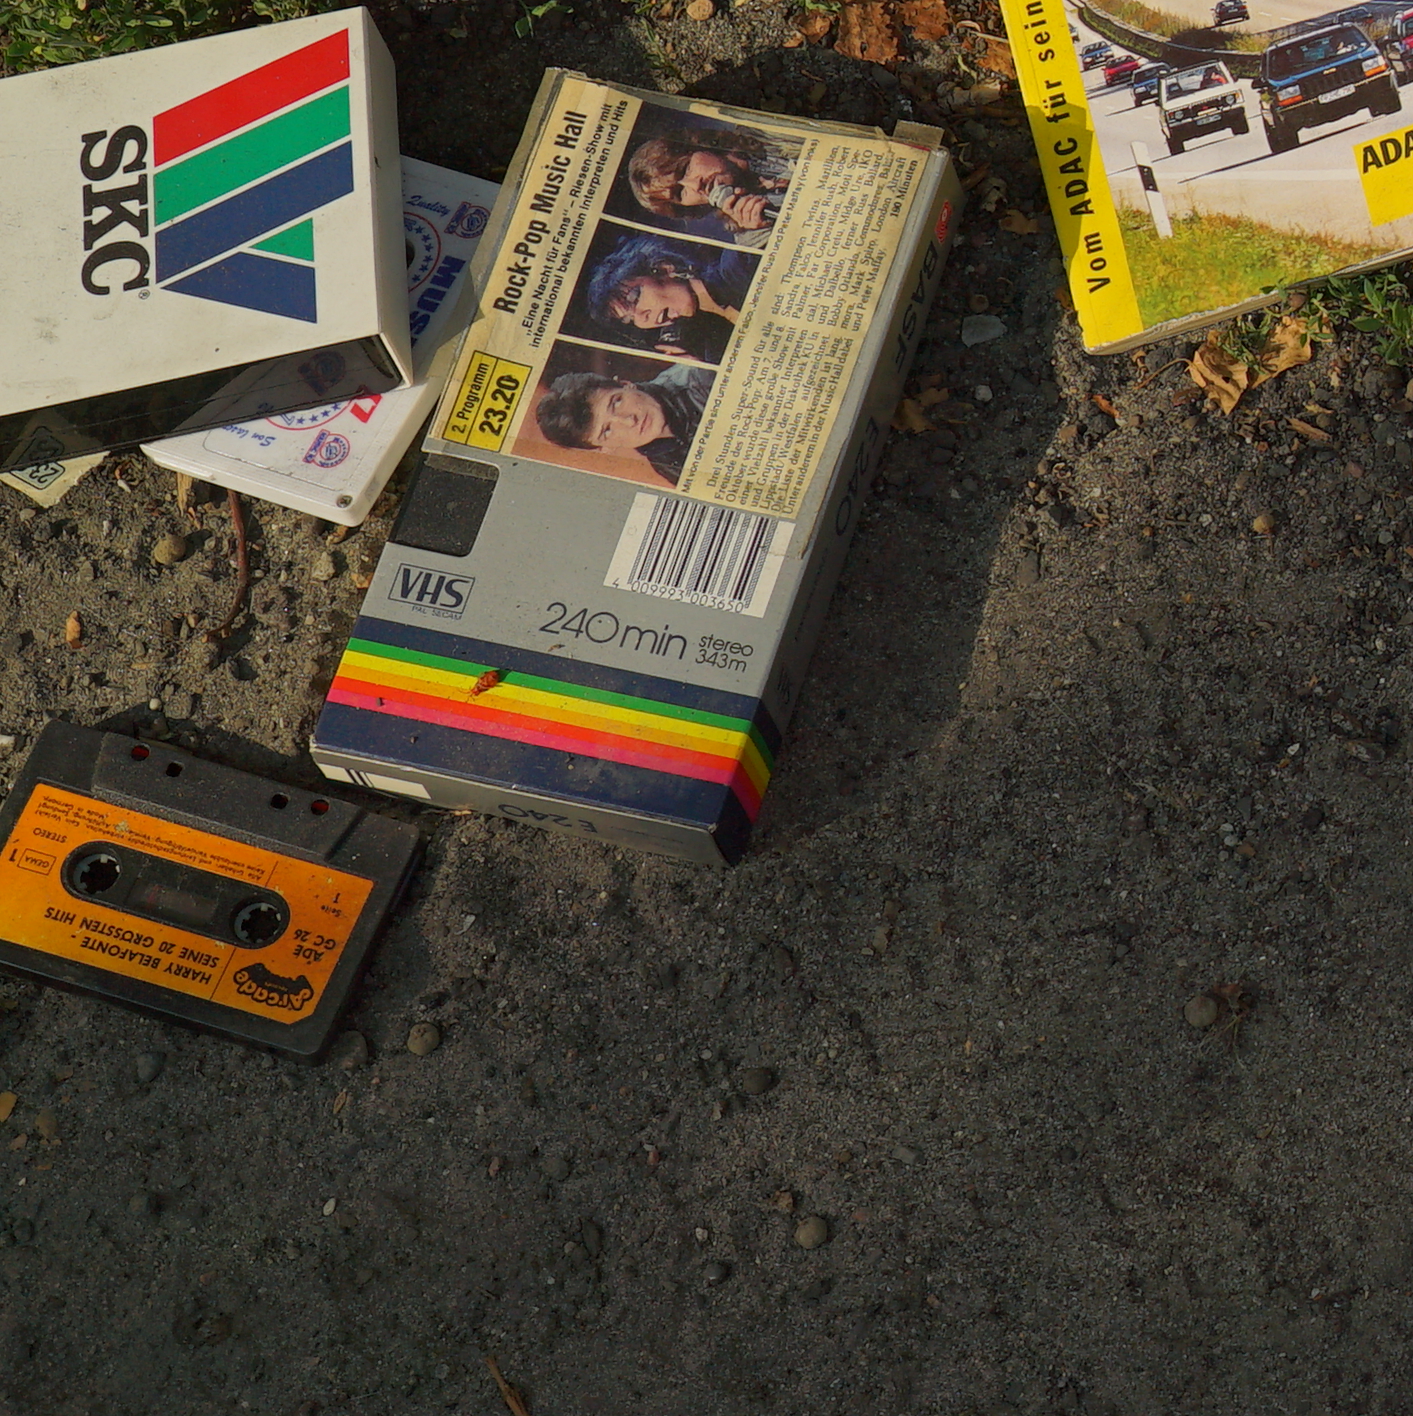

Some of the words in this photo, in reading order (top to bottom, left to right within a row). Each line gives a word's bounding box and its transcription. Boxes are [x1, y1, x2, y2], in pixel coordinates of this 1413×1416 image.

[610, 99, 628, 121] Hits
[1038, 77, 1071, 123] für
[603, 122, 620, 145] und
[577, 146, 614, 210] Interpreten
[894, 158, 920, 200] Minuten
[1051, 136, 1095, 217] ADAC
[80, 126, 150, 296] SKC
[491, 218, 552, 314] Rock-Pop
[529, 154, 573, 214] Music
[553, 109, 588, 149] Hall
[531, 264, 555, 300] Nacht
[545, 246, 561, 263] für
[565, 122, 608, 198] Riesen-Show
[596, 102, 613, 122] mit
[554, 212, 589, 273] bekannten
[1076, 231, 1114, 294] Vom
[526, 273, 567, 347] international
[888, 237, 942, 373] BASF
[759, 319, 774, 337] alle
[753, 338, 767, 353] für
[456, 362, 492, 420] Programm
[727, 355, 764, 420] Super-Sound
[477, 374, 522, 436] 23.20
[451, 420, 467, 433] 2.
[714, 422, 739, 464] Stunden
[706, 465, 722, 487] Drei
[401, 568, 469, 608] VHS
[631, 581, 686, 601] 009993
[691, 592, 744, 613] 003650
[695, 649, 748, 673] 343m
[699, 633, 754, 657] stereo
[31, 826, 67, 843] STEREO
[23, 854, 50, 869] GEMA
[42, 905, 76, 925] HITS
[320, 904, 341, 916] Seite
[158, 939, 175, 955] 20
[293, 928, 311, 943] 26
[314, 934, 336, 950] GC
[78, 935, 161, 970] BELAFONTE
[178, 946, 219, 968] SEINE
[163, 959, 212, 984] HARRY
[233, 967, 313, 1013] Arcade
